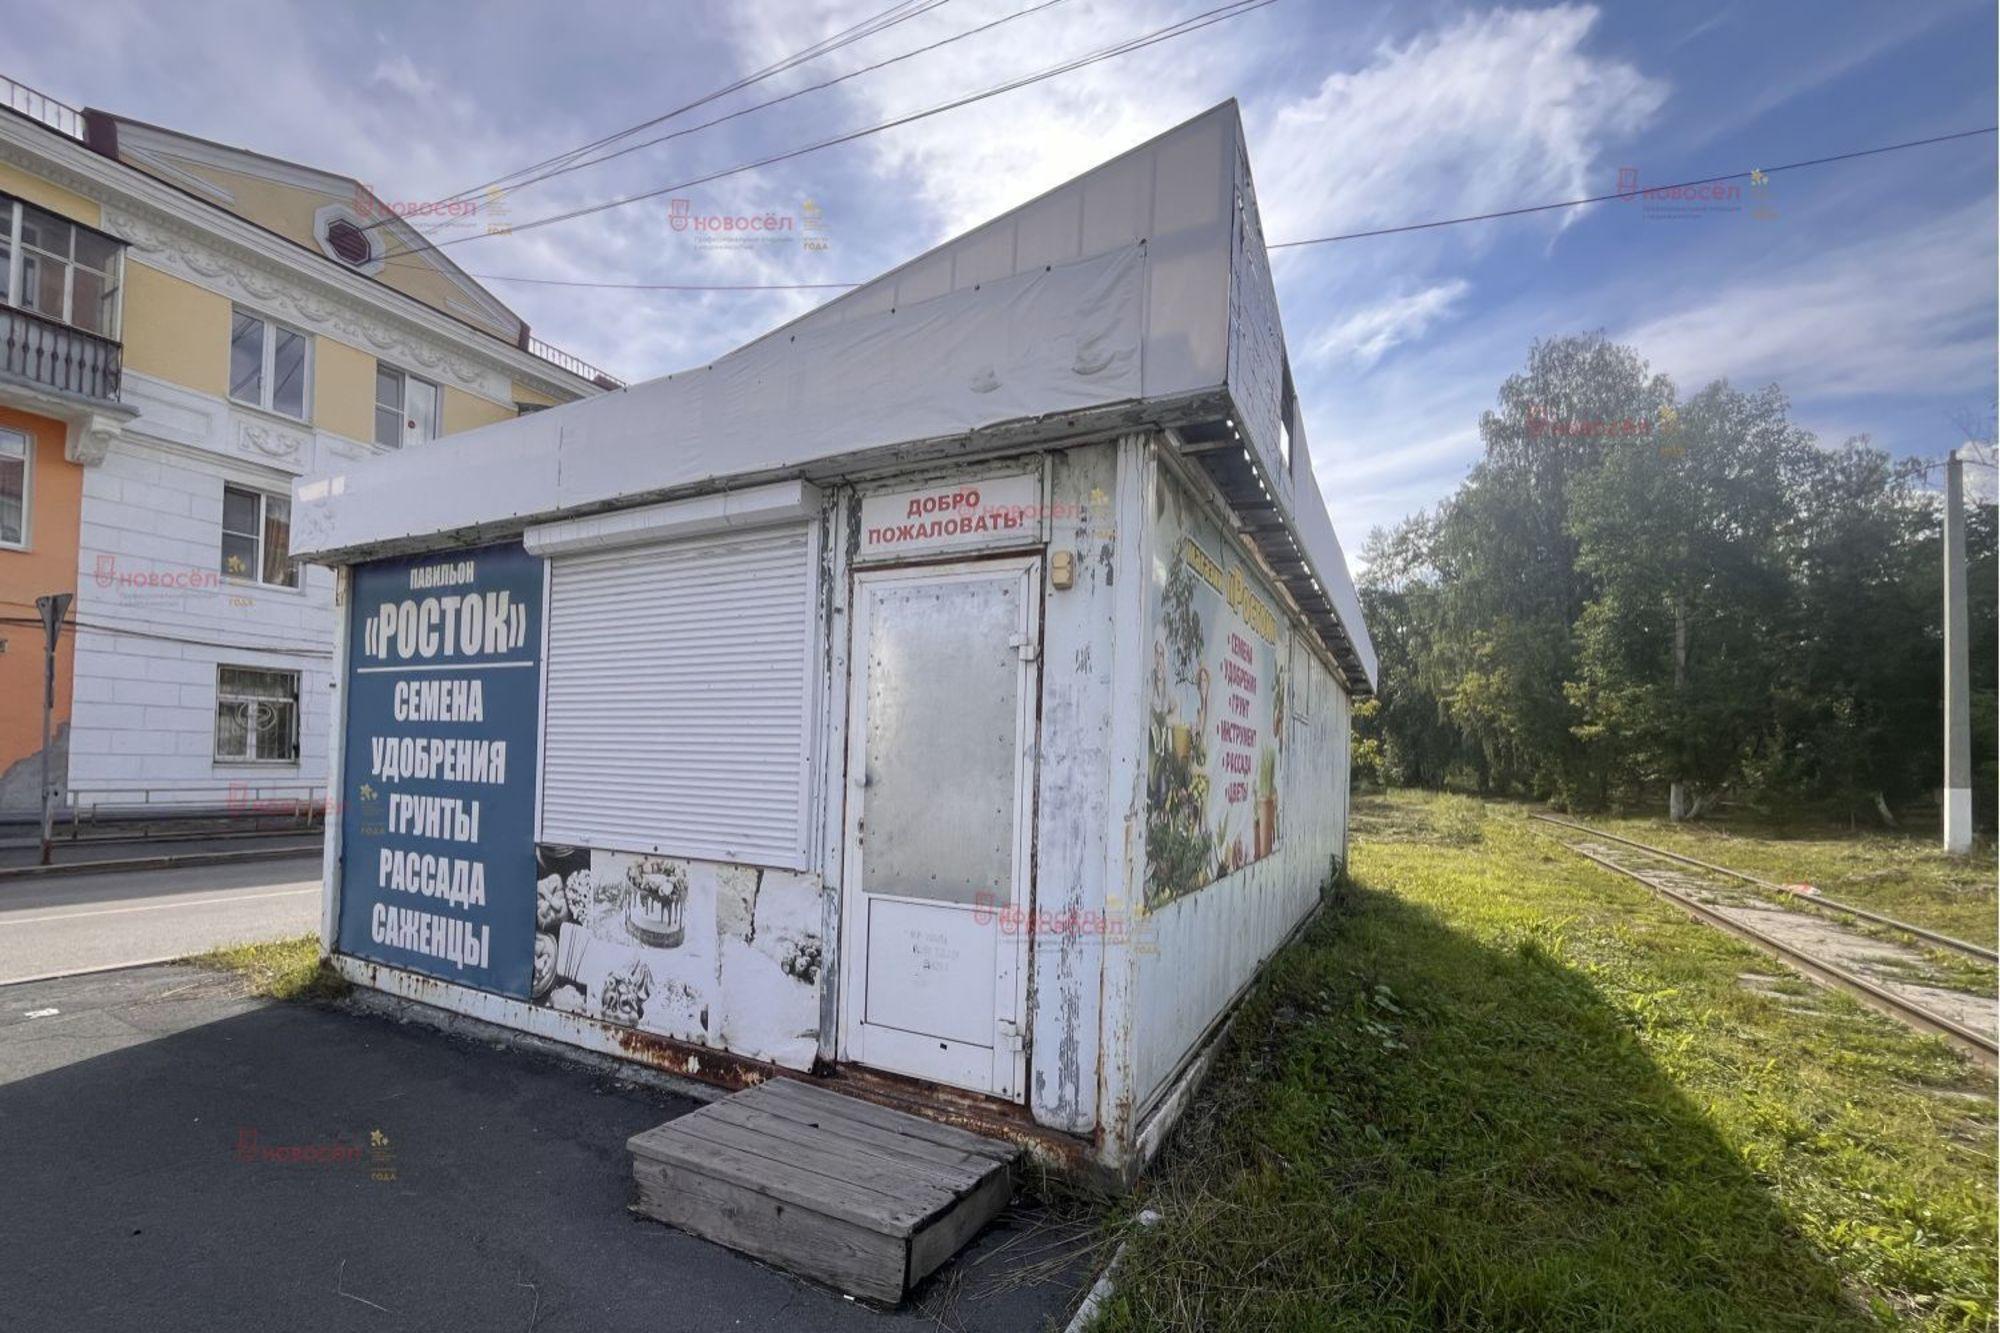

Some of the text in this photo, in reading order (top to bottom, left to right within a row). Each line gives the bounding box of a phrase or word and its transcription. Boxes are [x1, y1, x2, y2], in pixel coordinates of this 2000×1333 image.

[868, 511, 1024, 545] ПОЖАЛОВАТЬ!
[906, 490, 981, 519] ДОБРО
[409, 561, 474, 590] ПАВИЛЬОН
[365, 592, 526, 660] «РОСТОК»
[394, 680, 483, 723] СЕМЕНА
[371, 737, 507, 784] УДОБРЕНИЯ
[388, 793, 479, 843] ГРУНТЫ
[379, 848, 486, 910] РАССАДА
[371, 903, 490, 970] САЖЕНЦЫ
